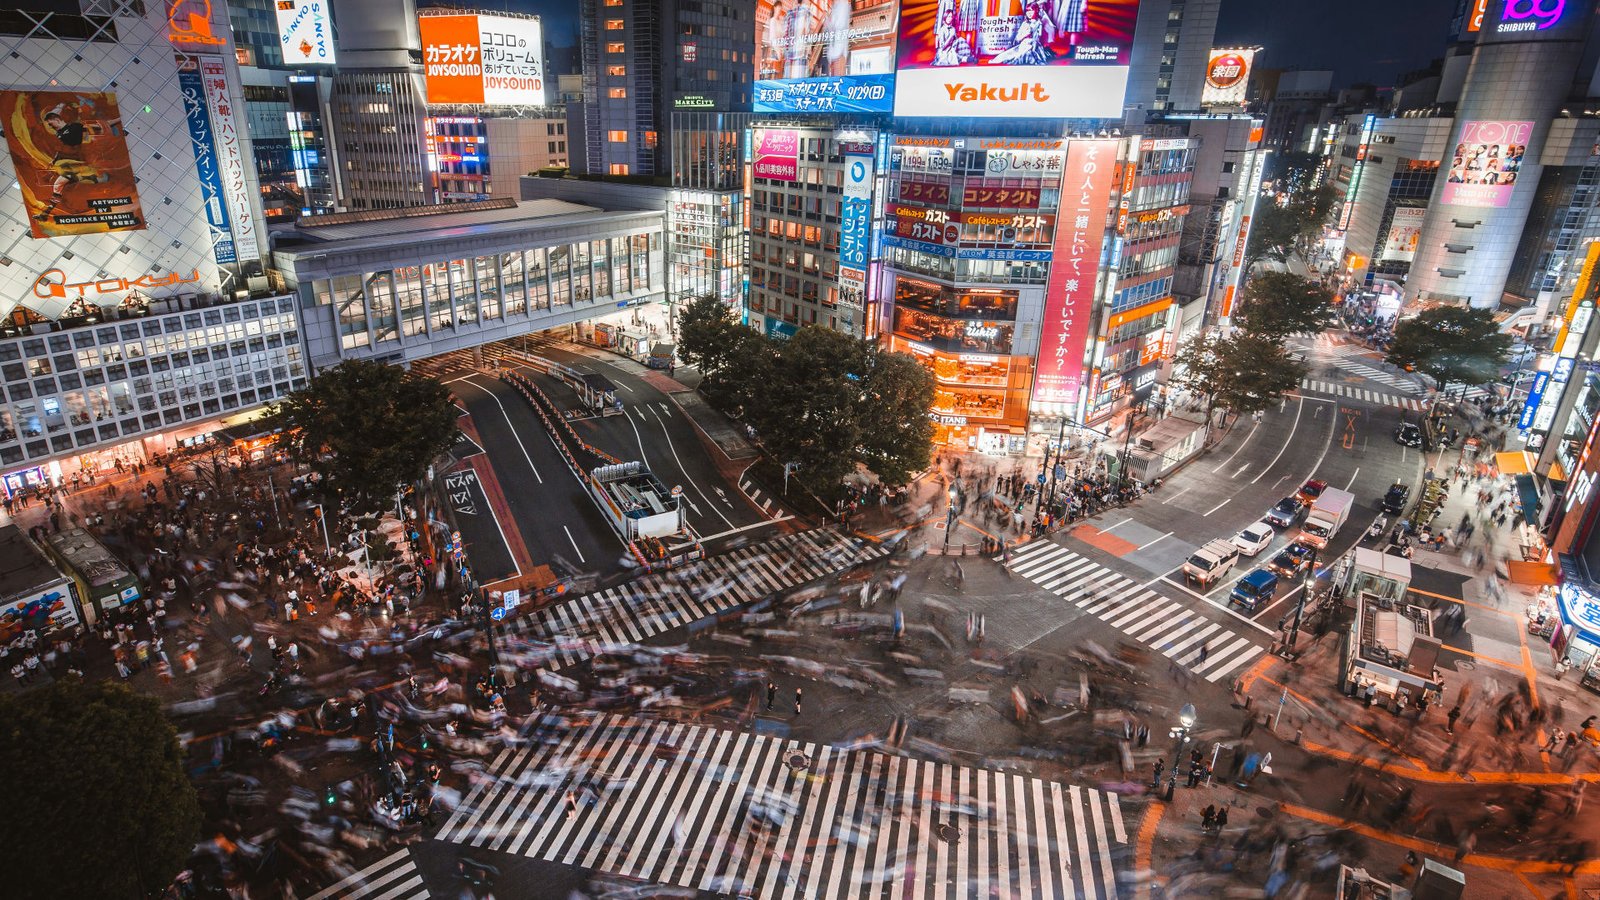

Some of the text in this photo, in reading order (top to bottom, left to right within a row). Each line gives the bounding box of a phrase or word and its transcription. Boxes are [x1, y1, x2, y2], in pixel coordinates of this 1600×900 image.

[1498, 23, 1536, 32] SHIBUYA
[168, 34, 226, 45] TOKYU
[481, 32, 526, 47] ココロの
[426, 44, 478, 62] カラオケ
[1076, 46, 1118, 54] Tough-Man
[482, 49, 540, 65] ボリューム、
[428, 64, 481, 77] JOYSOUND
[484, 64, 541, 77] あげていこう。
[1212, 65, 1241, 78] 楽園
[484, 78, 542, 91] JOYSOUND
[788, 79, 844, 96] スプリンターズ
[944, 83, 1050, 102] Yakult
[795, 97, 834, 110] ステークス
[1012, 155, 1061, 170] しゃぶ葉
[964, 189, 1037, 204] コンタクト
[59, 213, 131, 224] NORITAKE KINASHI
[925, 210, 950, 223] ガスト
[1011, 215, 1047, 228] ガスト
[912, 222, 942, 240] ガスト
[987, 251, 1051, 260] 英会話イーオン
[1137, 369, 1157, 385] LUSH
